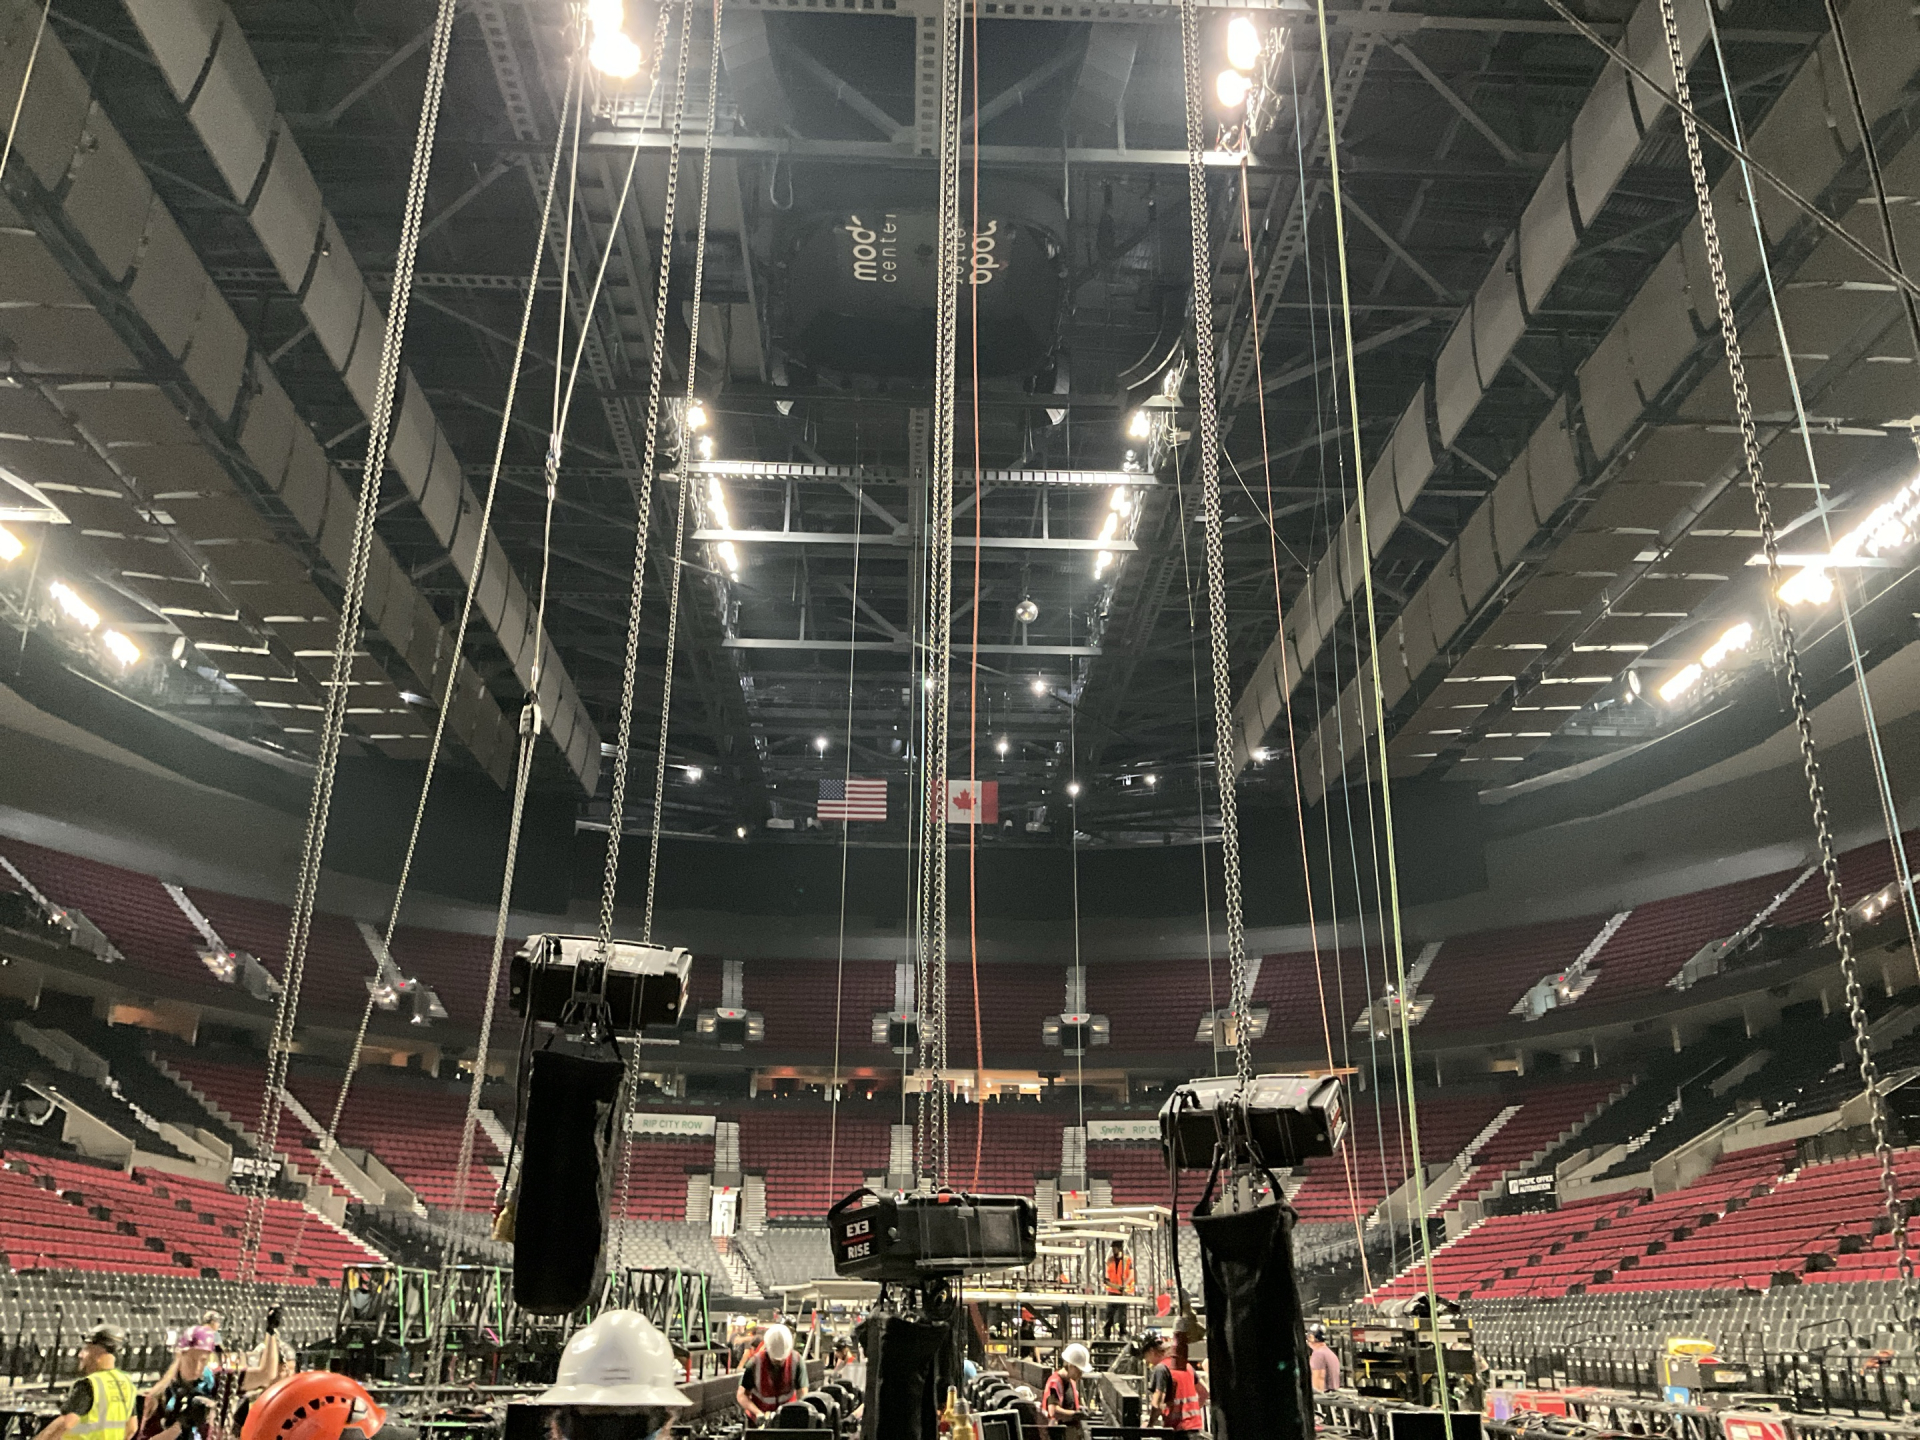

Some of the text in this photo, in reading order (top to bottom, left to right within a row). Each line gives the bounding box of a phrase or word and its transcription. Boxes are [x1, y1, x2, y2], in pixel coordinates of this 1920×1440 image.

[845, 215, 877, 282] mod
[642, 1119, 657, 1128] RIP
[659, 1119, 679, 1129] CITY
[682, 1120, 703, 1129] ROW
[1100, 1125, 1163, 1135] Sprite RIP CIT
[847, 1242, 870, 1259] RISE
